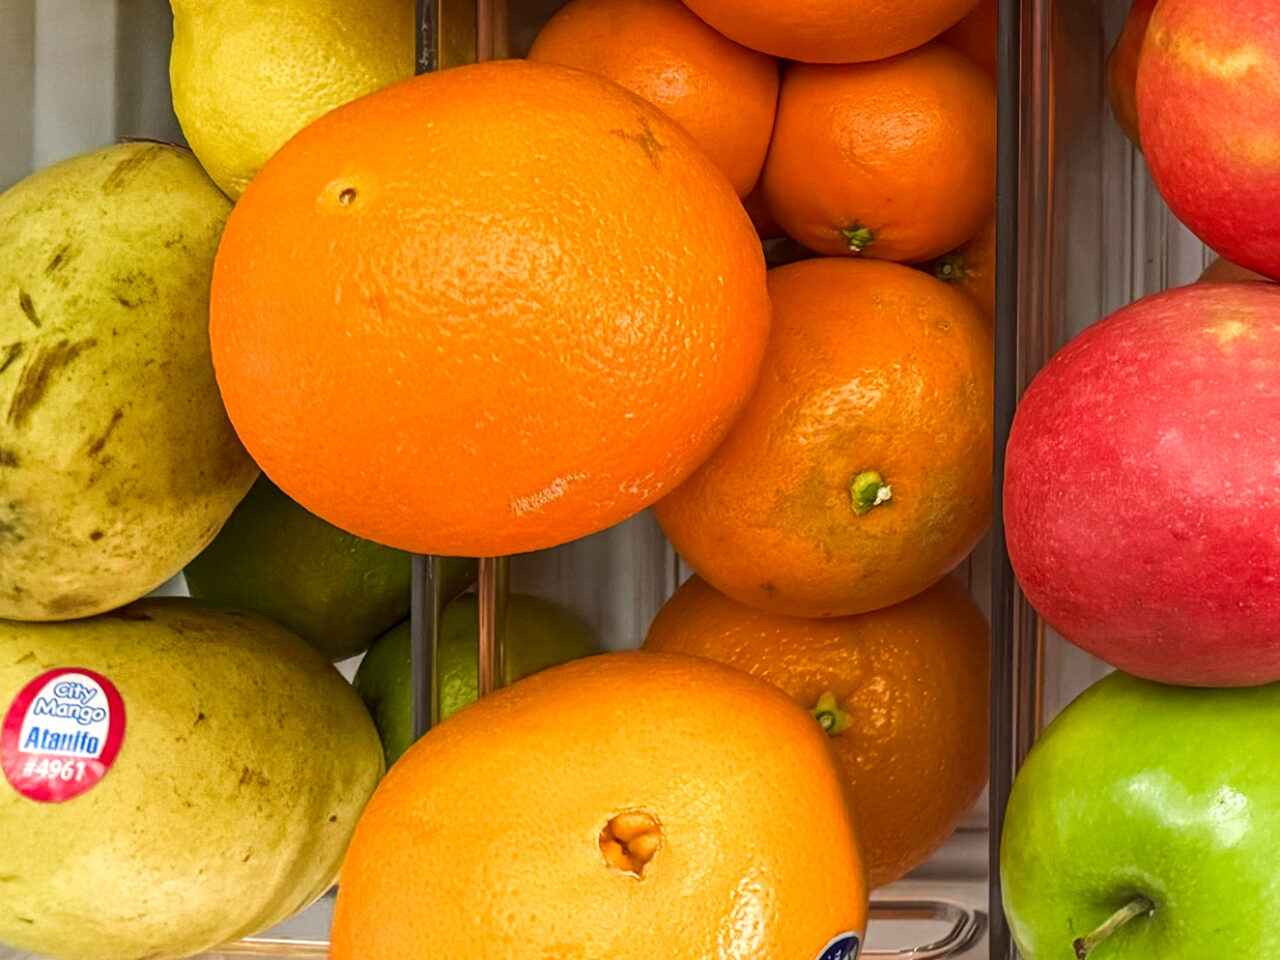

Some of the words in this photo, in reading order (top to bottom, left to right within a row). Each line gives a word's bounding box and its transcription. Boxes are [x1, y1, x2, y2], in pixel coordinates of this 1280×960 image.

[53, 681, 98, 705] City
[33, 697, 107, 725] Mango
[22, 756, 86, 782] #4961
